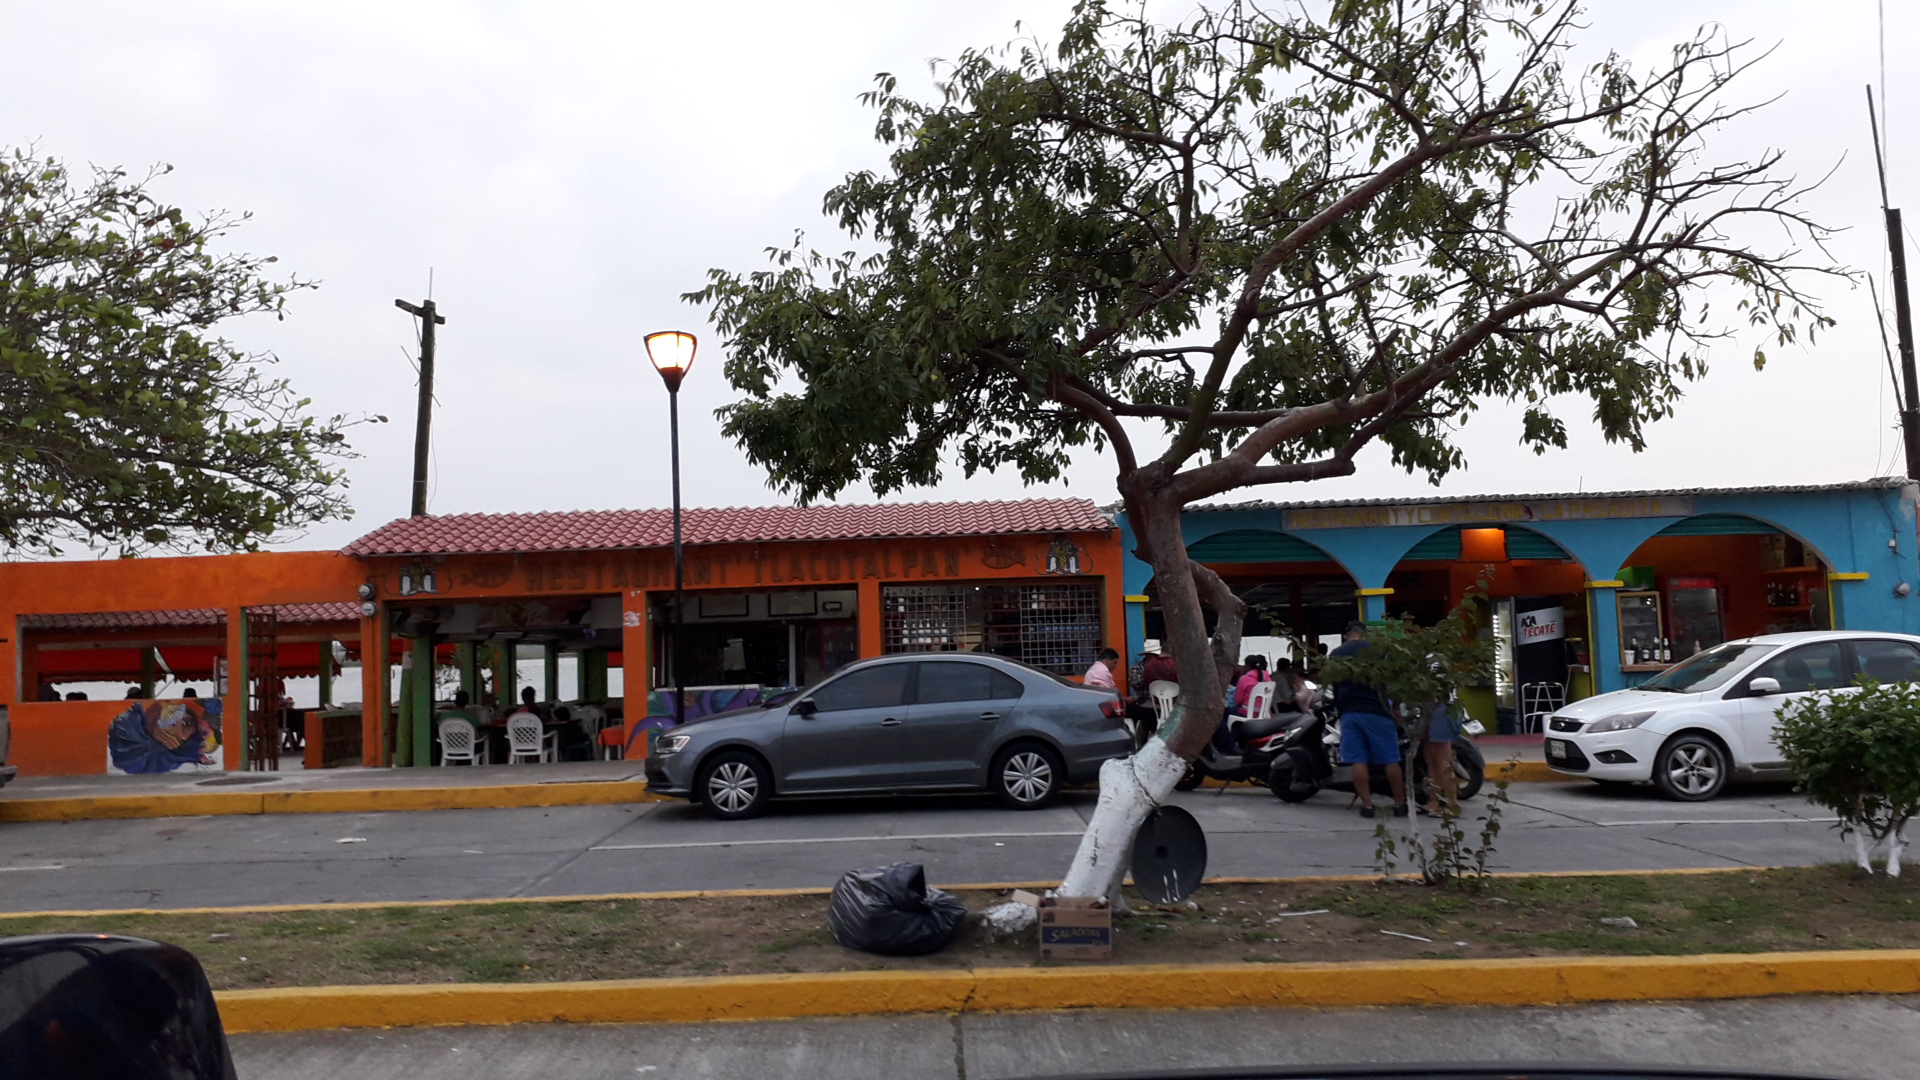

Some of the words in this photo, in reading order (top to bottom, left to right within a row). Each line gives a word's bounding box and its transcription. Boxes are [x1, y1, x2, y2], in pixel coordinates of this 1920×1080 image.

[1541, 502, 1565, 518] LA
[1568, 498, 1662, 517] PASADITA
[1523, 623, 1556, 637] TECATE
